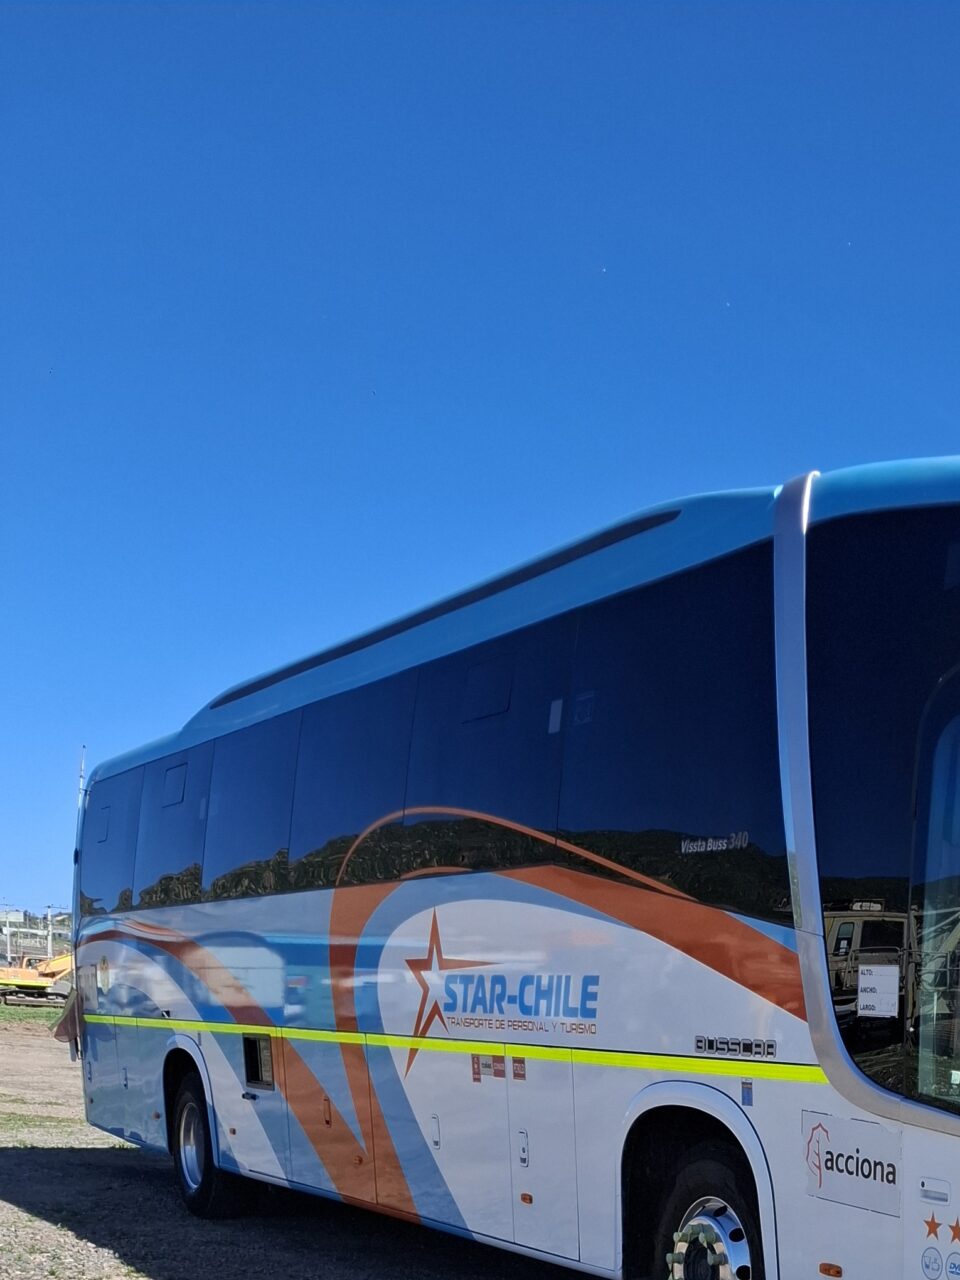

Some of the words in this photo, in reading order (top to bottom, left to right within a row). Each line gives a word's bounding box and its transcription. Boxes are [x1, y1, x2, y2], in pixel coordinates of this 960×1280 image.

[681, 838, 706, 854] Vissta
[707, 838, 728, 851] Buss
[729, 831, 749, 850] 340
[443, 974, 600, 1019] STAR-CHILE
[446, 1016, 494, 1029] TRANSPORTE
[495, 1018, 505, 1030] DE
[507, 1019, 549, 1033] PERSONAL
[552, 1022, 558, 1033] Y
[560, 1022, 597, 1035] TURISMO
[694, 1035, 777, 1058] BUSSCAR
[824, 1147, 897, 1185] acciona
